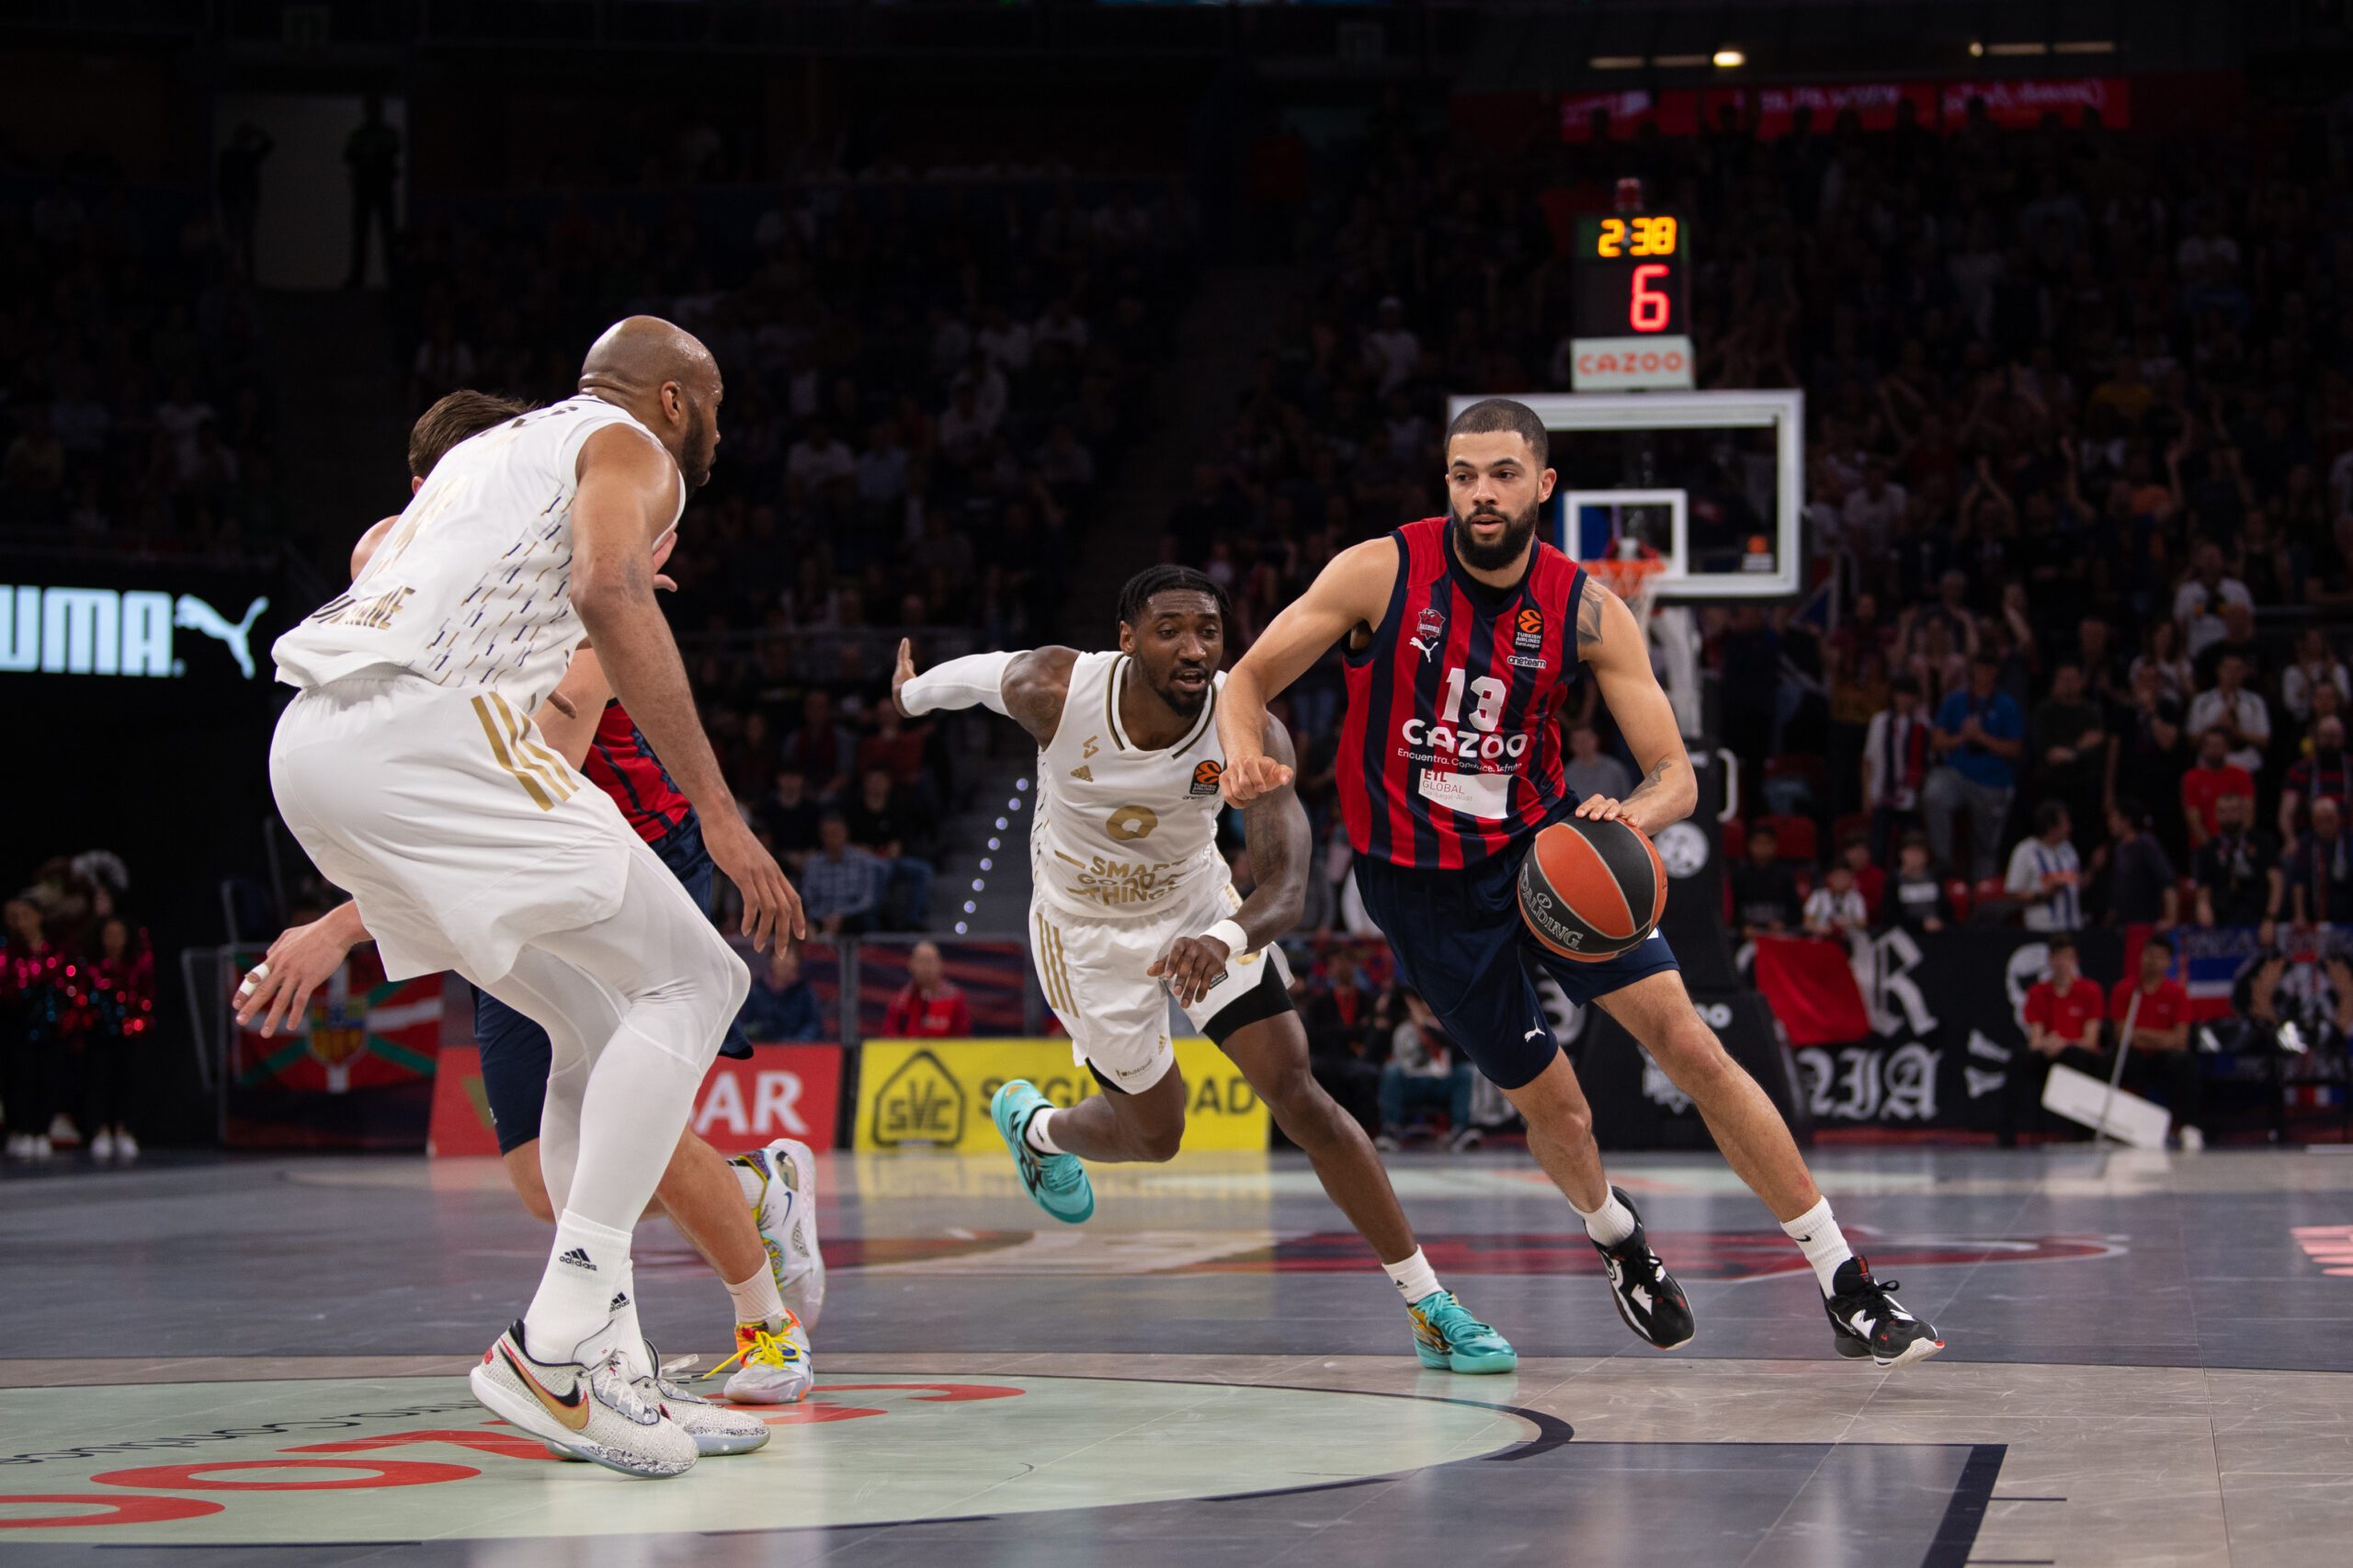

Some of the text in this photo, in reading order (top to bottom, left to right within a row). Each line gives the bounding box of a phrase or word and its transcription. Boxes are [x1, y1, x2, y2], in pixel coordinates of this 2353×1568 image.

[1630, 264, 1670, 332] 6
[1577, 351, 1684, 375] CAZOO
[1516, 636, 1540, 644] AIRLINES
[1517, 631, 1541, 640] TURKISH
[1507, 656, 1546, 668] oneteam
[1441, 667, 1507, 733] 13
[1402, 719, 1528, 759] CAZOO
[1397, 747, 1450, 765] Encuentra.
[1424, 769, 1447, 783] ETL
[1422, 779, 1465, 794] GLOBAL
[689, 1069, 812, 1136] AR
[559, 1256, 597, 1271] adidas
[608, 1299, 631, 1313] didas
